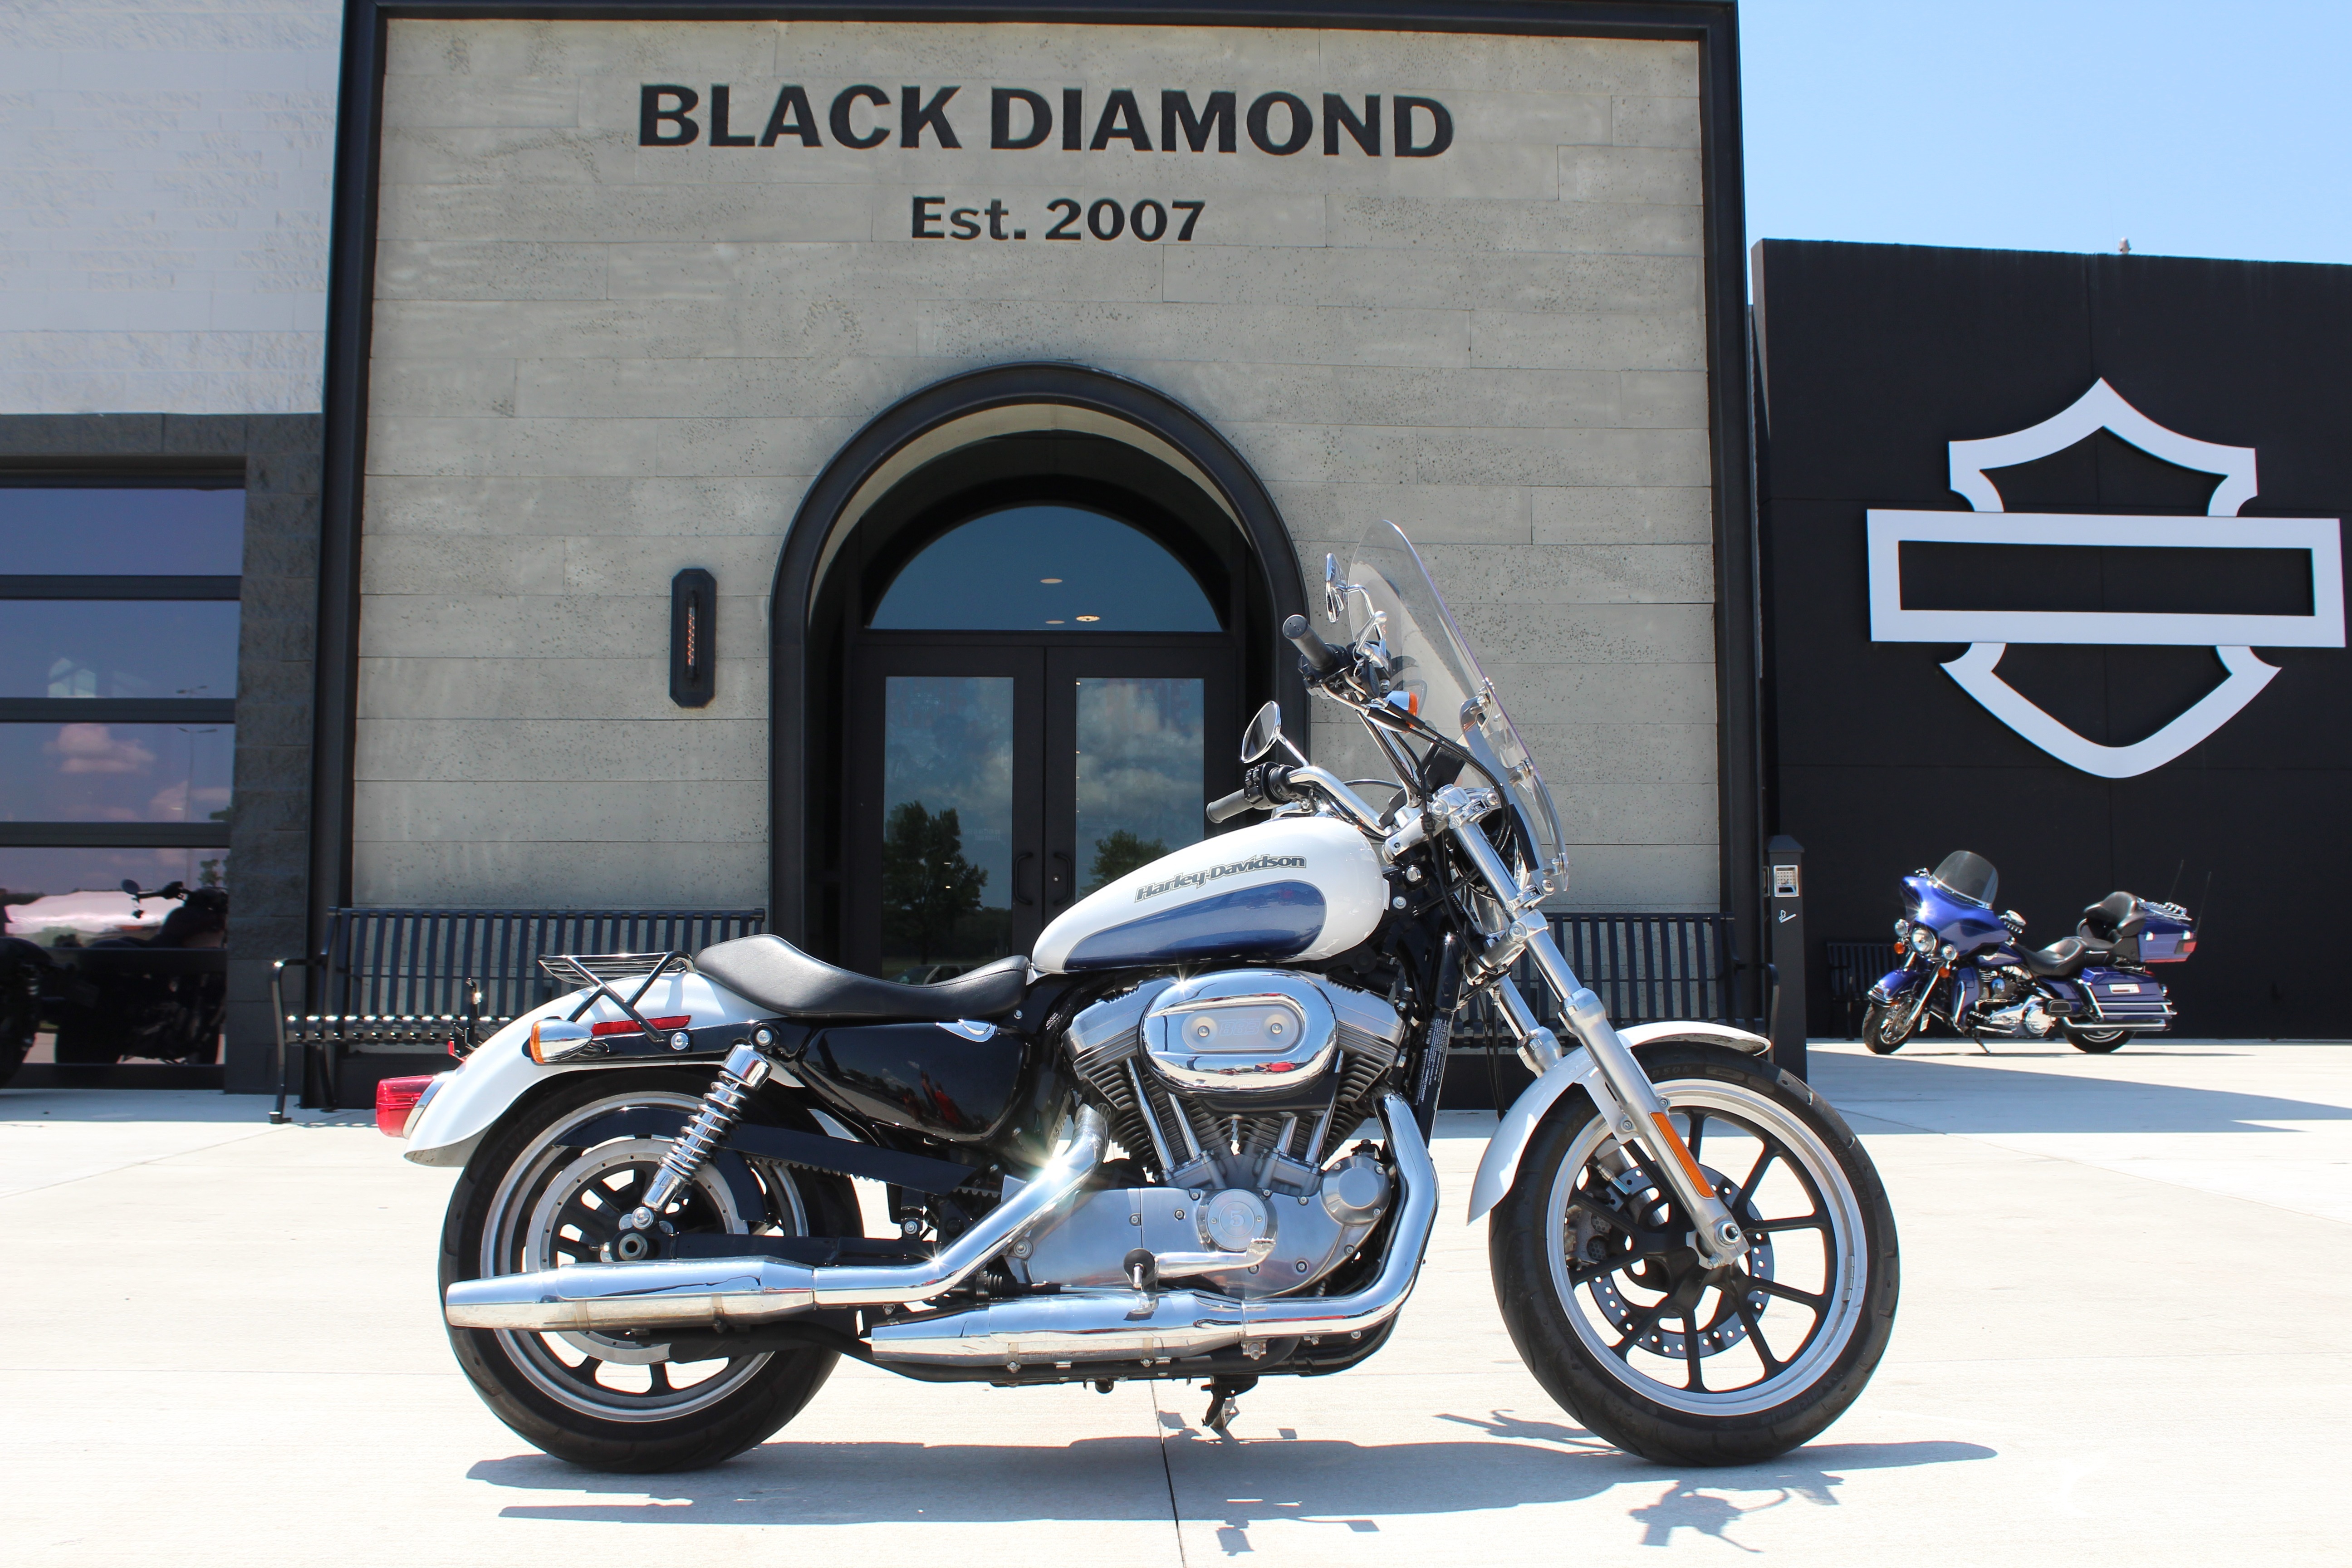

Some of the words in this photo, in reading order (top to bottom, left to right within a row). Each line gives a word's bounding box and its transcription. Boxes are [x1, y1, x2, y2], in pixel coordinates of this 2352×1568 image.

[639, 85, 961, 149] BLACK
[991, 88, 1453, 157] DIAMOND
[912, 197, 1026, 240] Est.
[1046, 199, 1205, 241] 2007
[1135, 855, 1306, 902] Harley-Davidson
[1219, 1021, 1260, 1036] 883
[1230, 1209, 1245, 1227] 5
